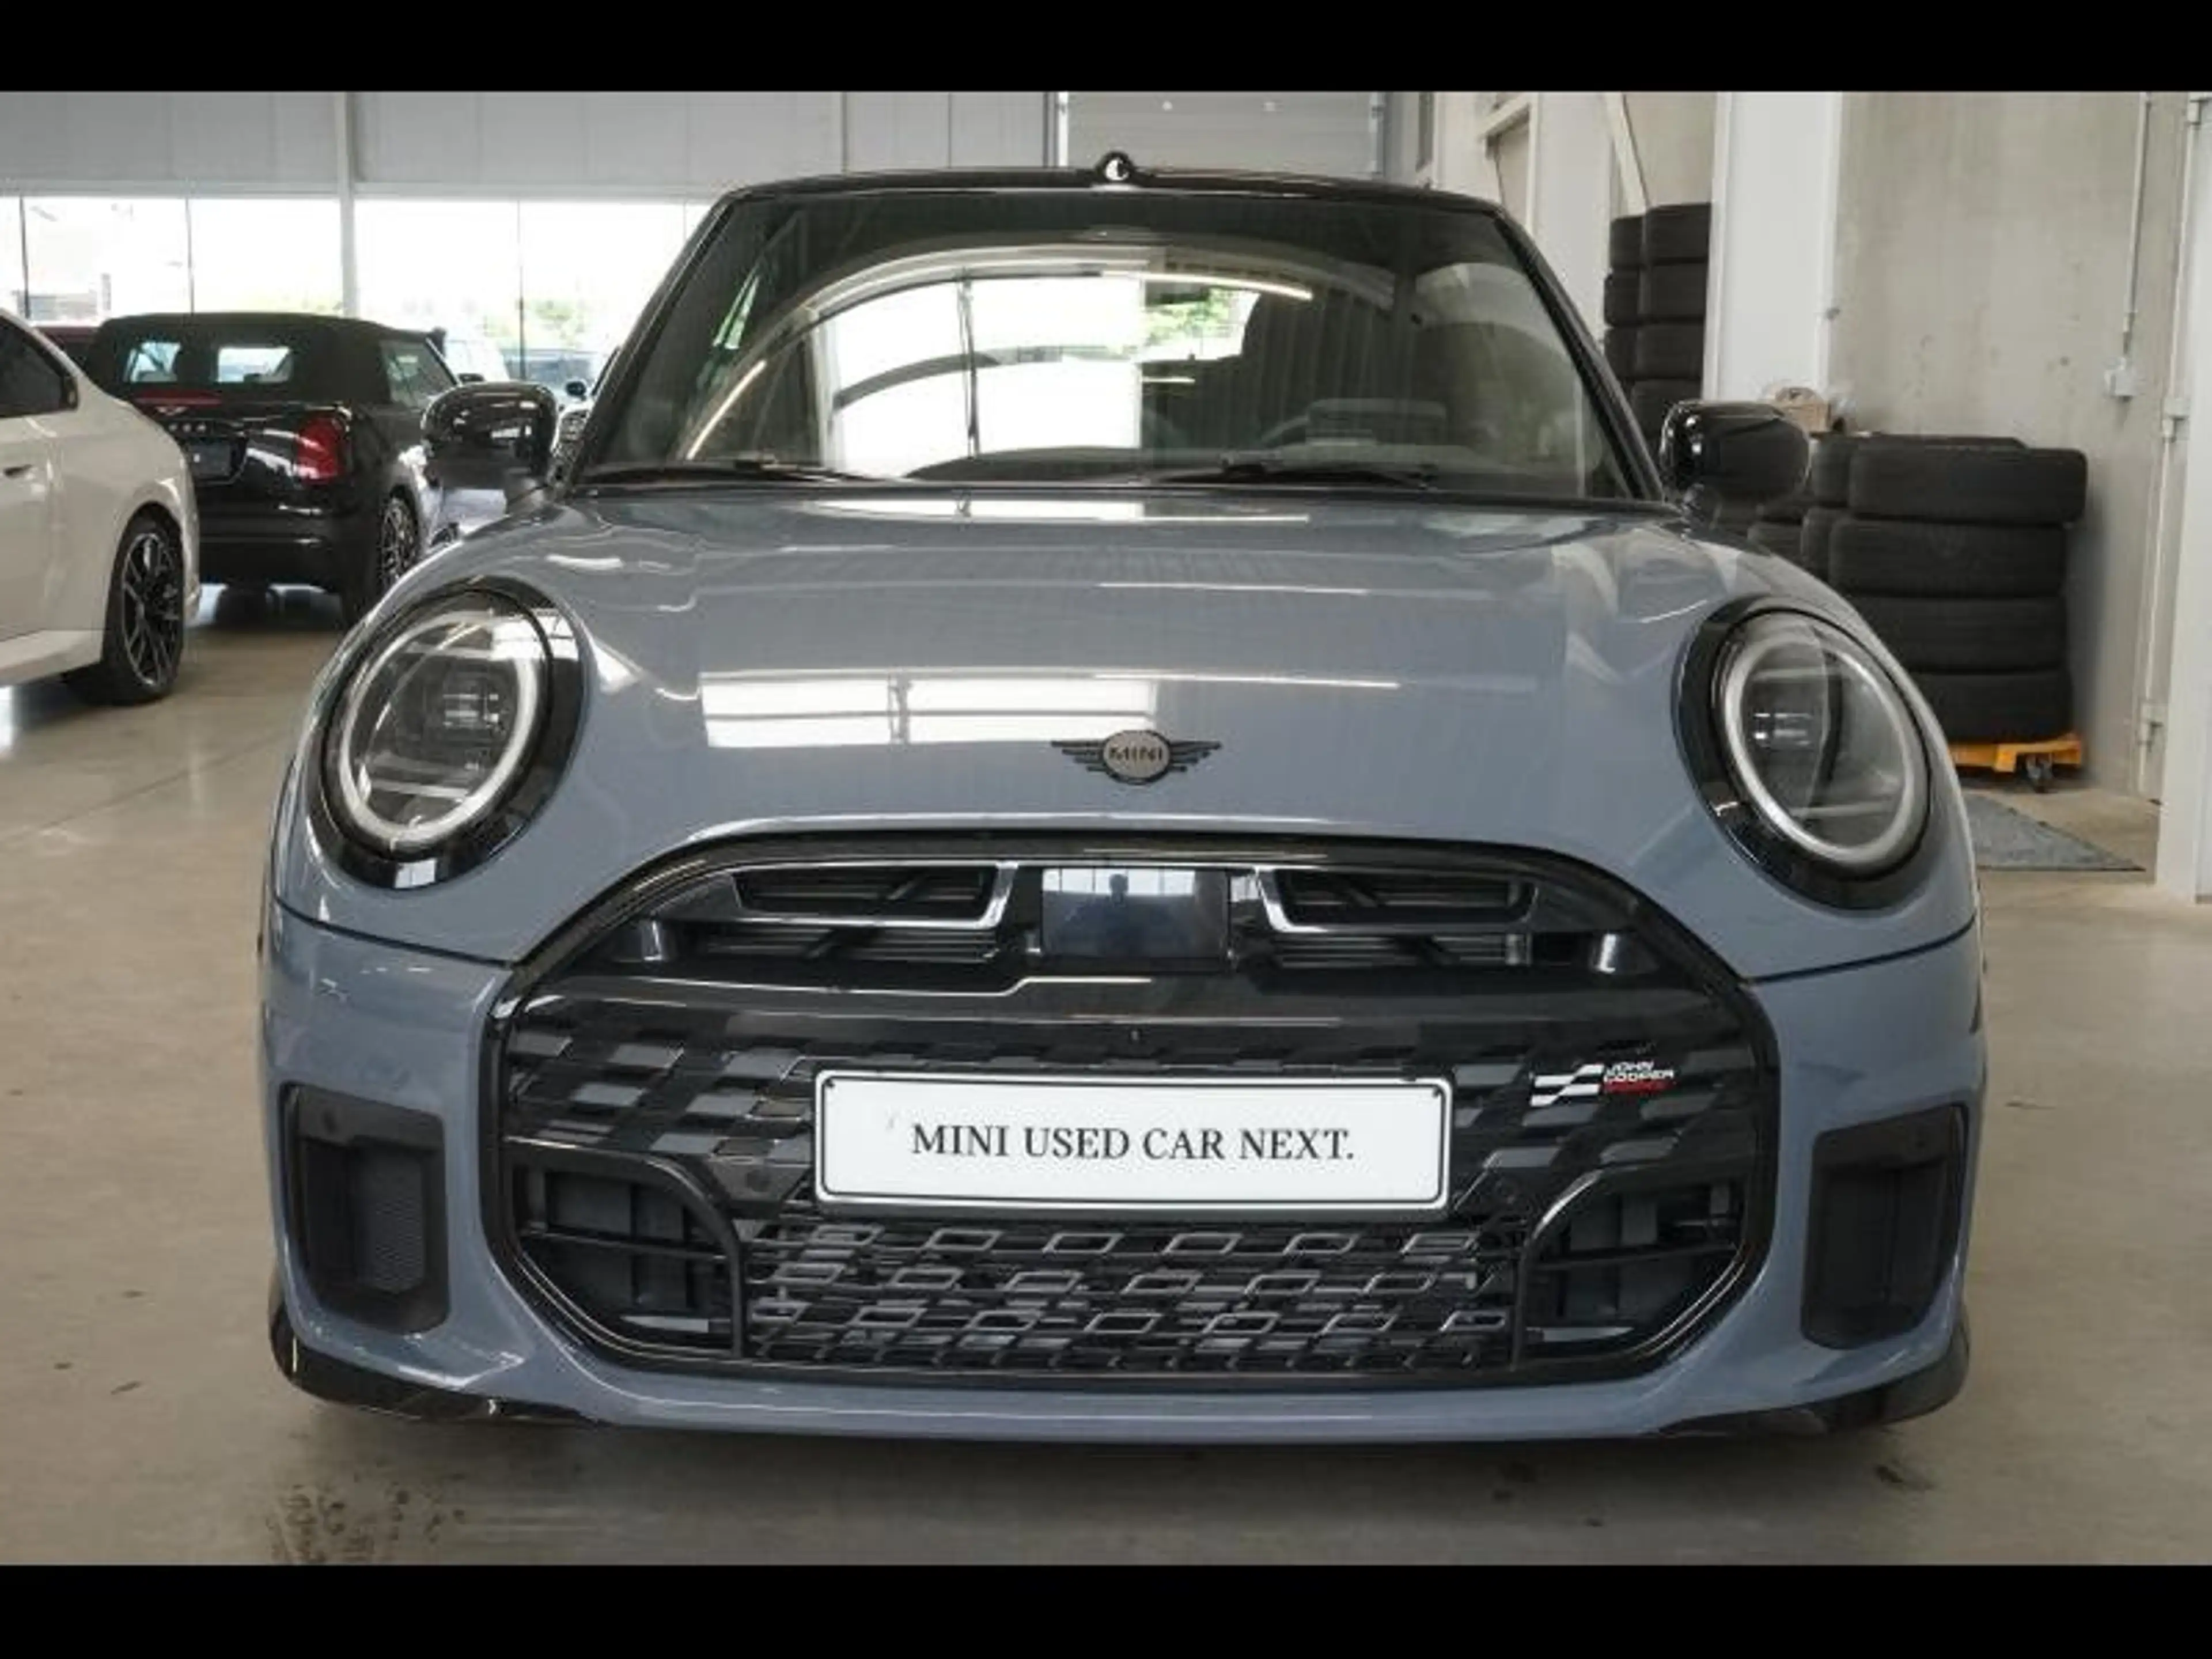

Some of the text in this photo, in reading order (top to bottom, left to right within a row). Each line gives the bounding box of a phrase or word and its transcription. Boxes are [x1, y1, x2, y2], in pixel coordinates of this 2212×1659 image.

[1108, 745, 1162, 761] MINI
[911, 1123, 1354, 1160] MINI USED CAR NEXT.
